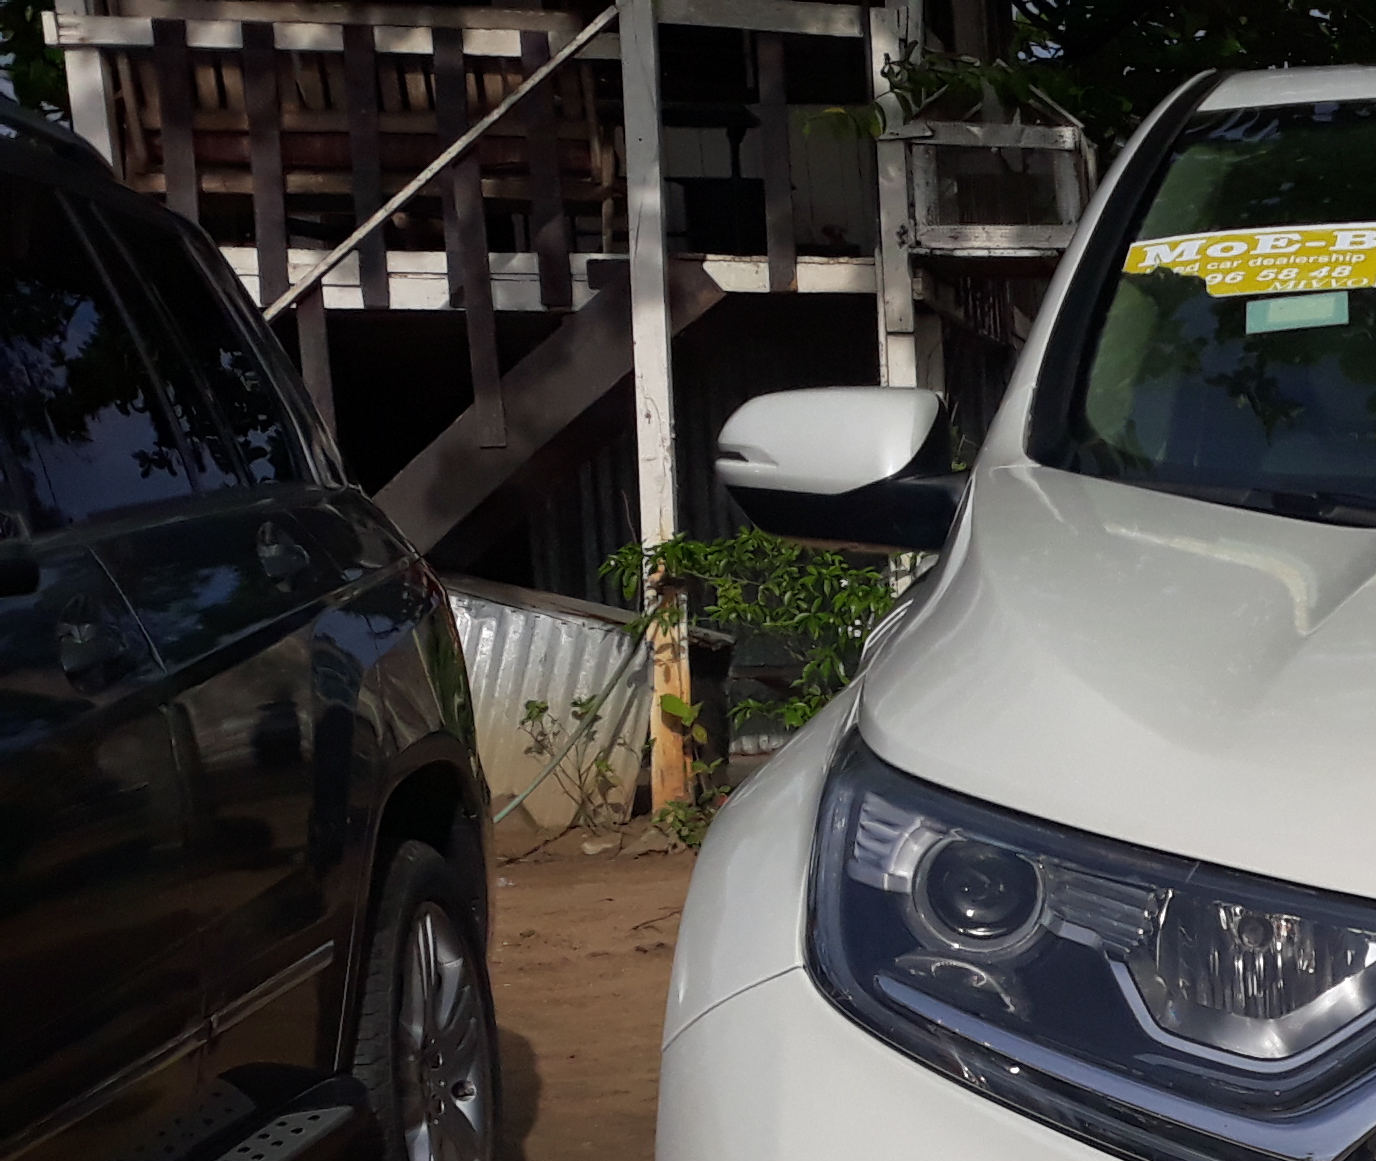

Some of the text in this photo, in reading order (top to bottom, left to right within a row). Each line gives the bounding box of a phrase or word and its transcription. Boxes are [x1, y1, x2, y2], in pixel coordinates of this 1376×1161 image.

[1207, 260, 1243, 270] car
[1248, 253, 1366, 267] dealership
[1256, 268, 1299, 281] 58
[1308, 265, 1352, 278] 48
